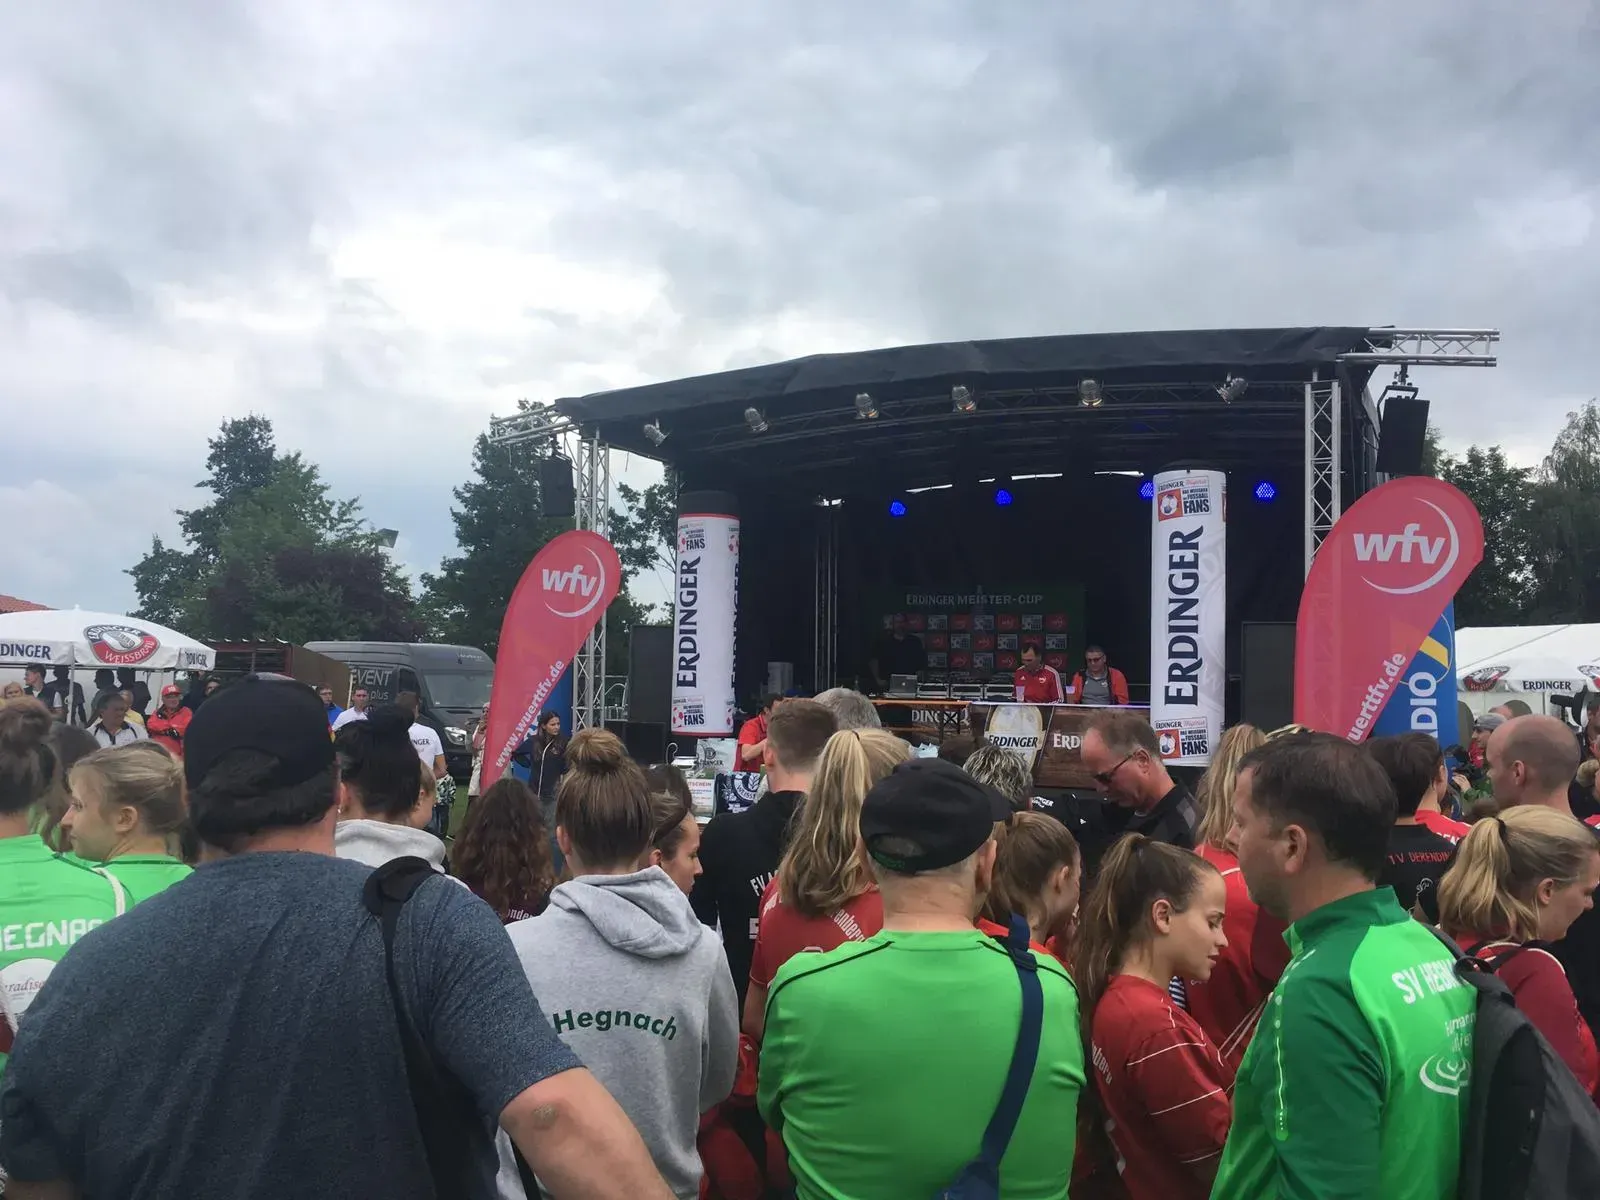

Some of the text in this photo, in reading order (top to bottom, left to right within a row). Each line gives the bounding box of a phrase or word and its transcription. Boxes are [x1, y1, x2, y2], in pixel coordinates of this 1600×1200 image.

[1183, 499, 1209, 514] FANS
[686, 538, 706, 550] FANS
[1353, 523, 1446, 565] wfv
[542, 564, 597, 597] wfv
[906, 594, 955, 606] ERDINGER
[676, 556, 701, 688] ERDINGER
[1164, 525, 1204, 706] ERDINGER
[351, 670, 392, 685] EVENT
[1523, 681, 1571, 691] ERDINGER
[370, 689, 389, 700] plus
[1347, 654, 1406, 741] uerttfv.de
[495, 660, 565, 768] www.wuerttfv.de
[684, 714, 705, 726] FANS
[1155, 721, 1182, 729] ERDINGER
[988, 735, 1039, 748] ERDINGER
[1182, 740, 1208, 755] FANS
[1408, 851, 1451, 863] DERENDIN
[1391, 967, 1425, 1004] SV
[553, 1009, 678, 1041] Hegnach
